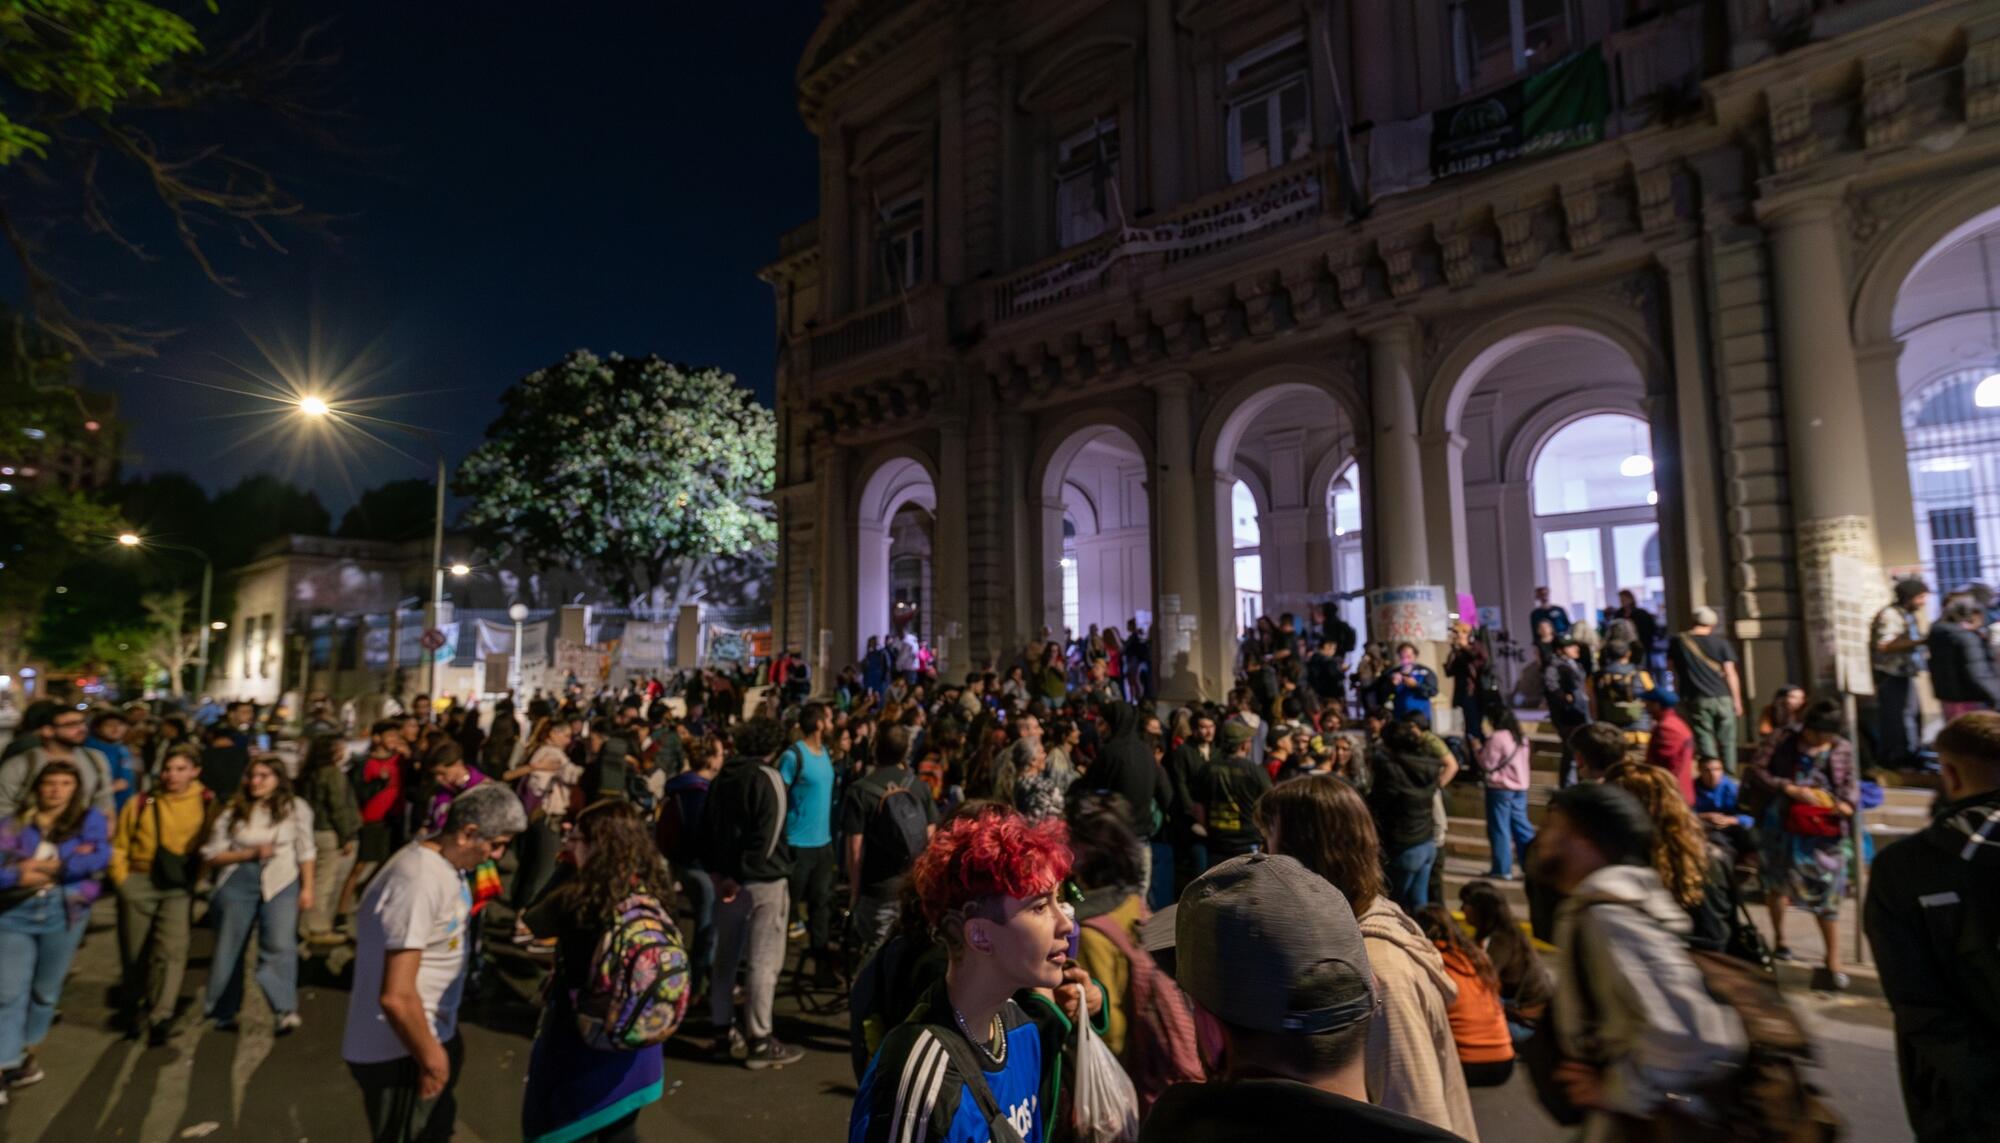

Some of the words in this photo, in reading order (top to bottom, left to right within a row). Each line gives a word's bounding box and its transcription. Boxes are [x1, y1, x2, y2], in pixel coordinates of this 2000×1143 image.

[1439, 153, 1491, 178] LAURA
[1180, 213, 1248, 240] JUSTICIA
[1251, 188, 1313, 221] SOCIAL
